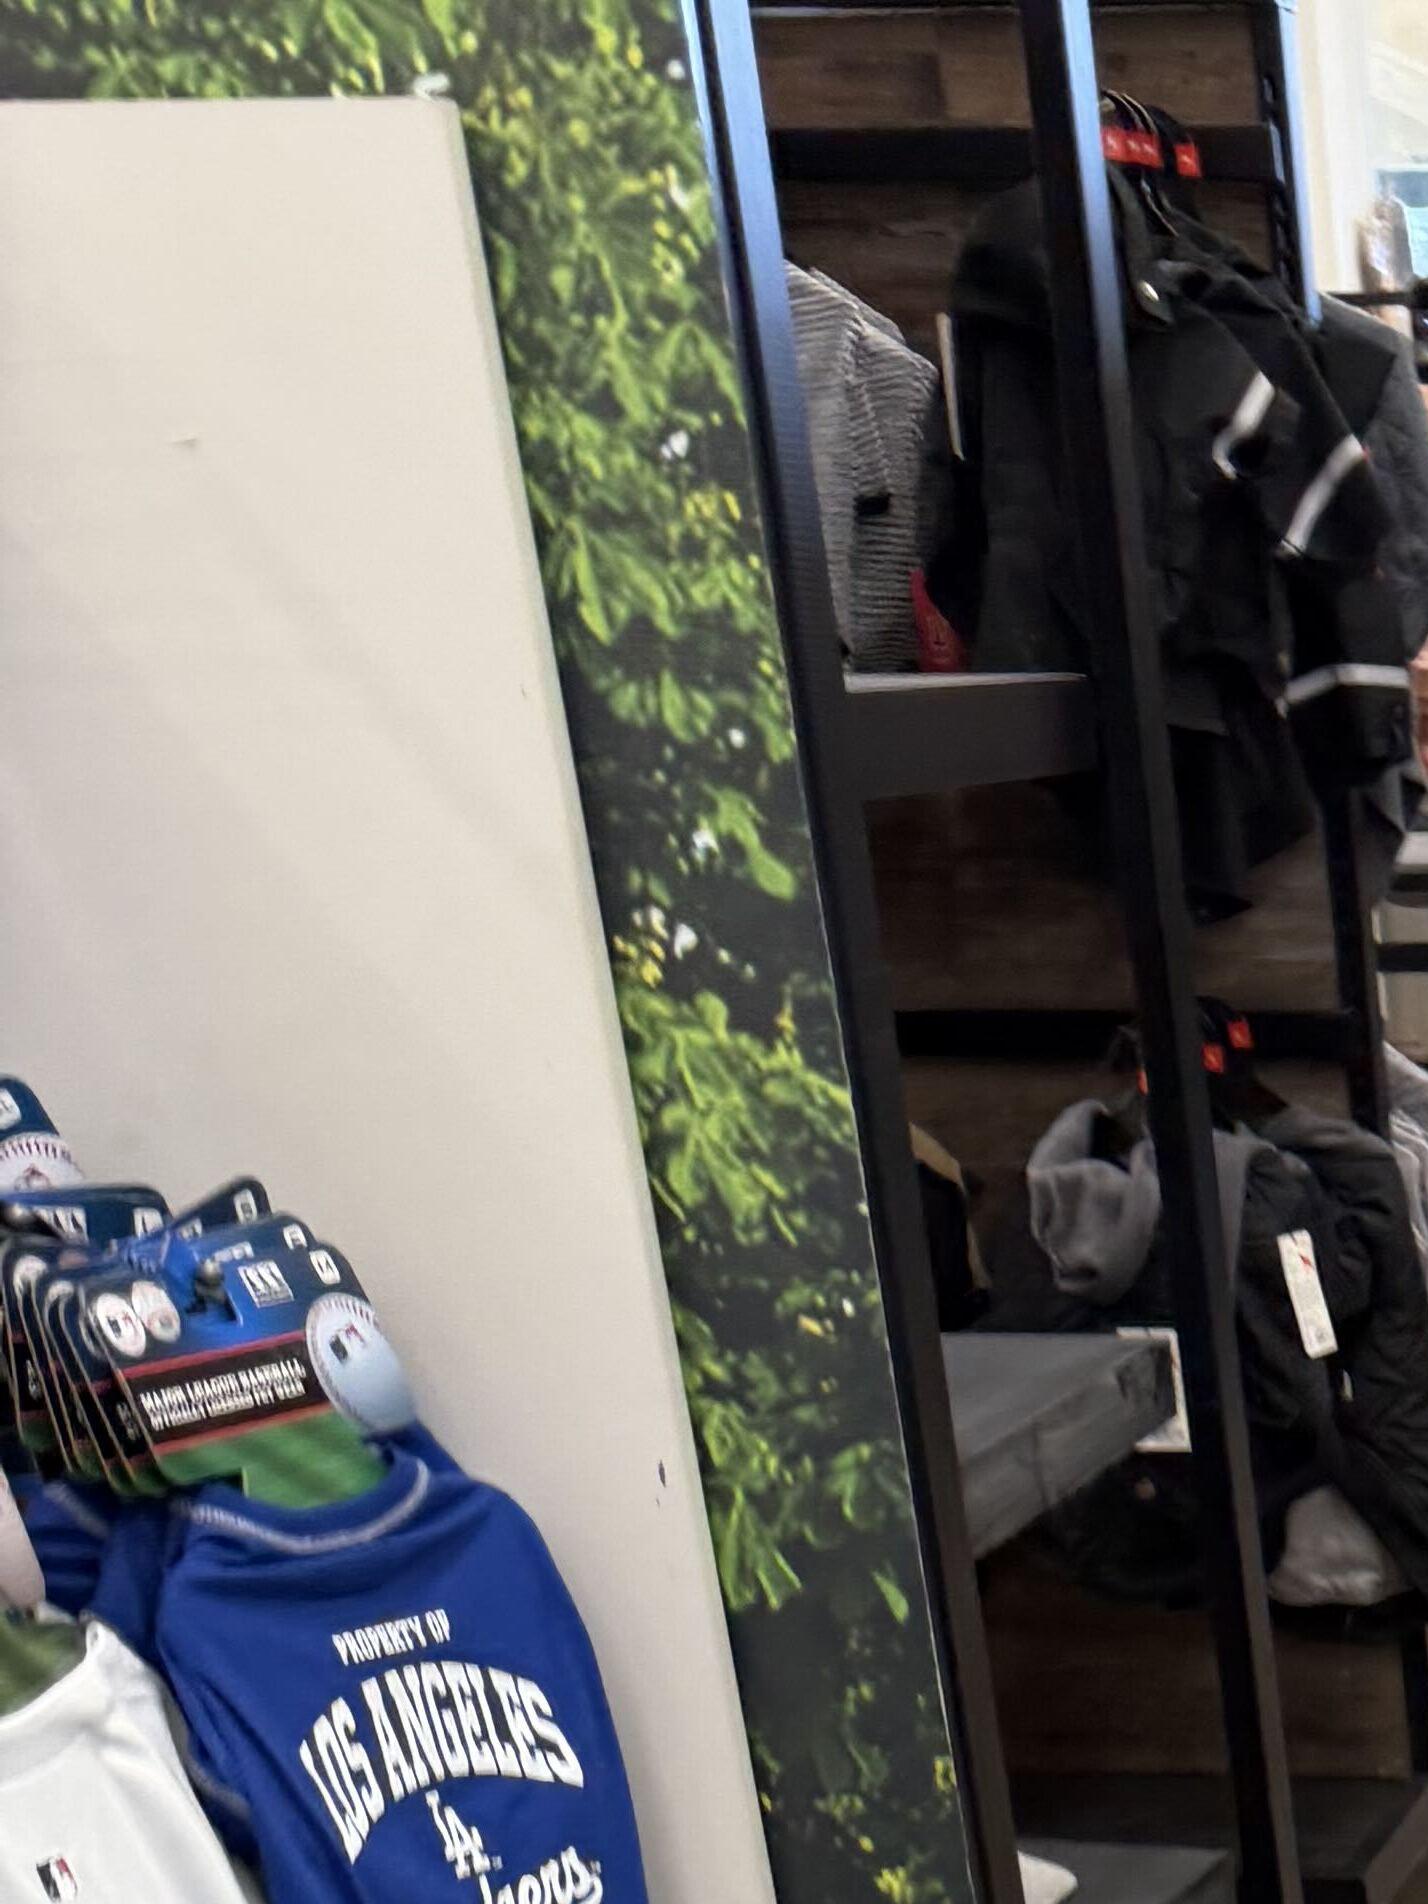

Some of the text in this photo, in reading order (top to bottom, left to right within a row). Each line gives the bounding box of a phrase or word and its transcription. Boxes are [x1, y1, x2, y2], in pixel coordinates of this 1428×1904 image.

[332, 1608, 451, 1666] PROPERTY OF
[300, 1661, 584, 1865] LOS ANGELES
